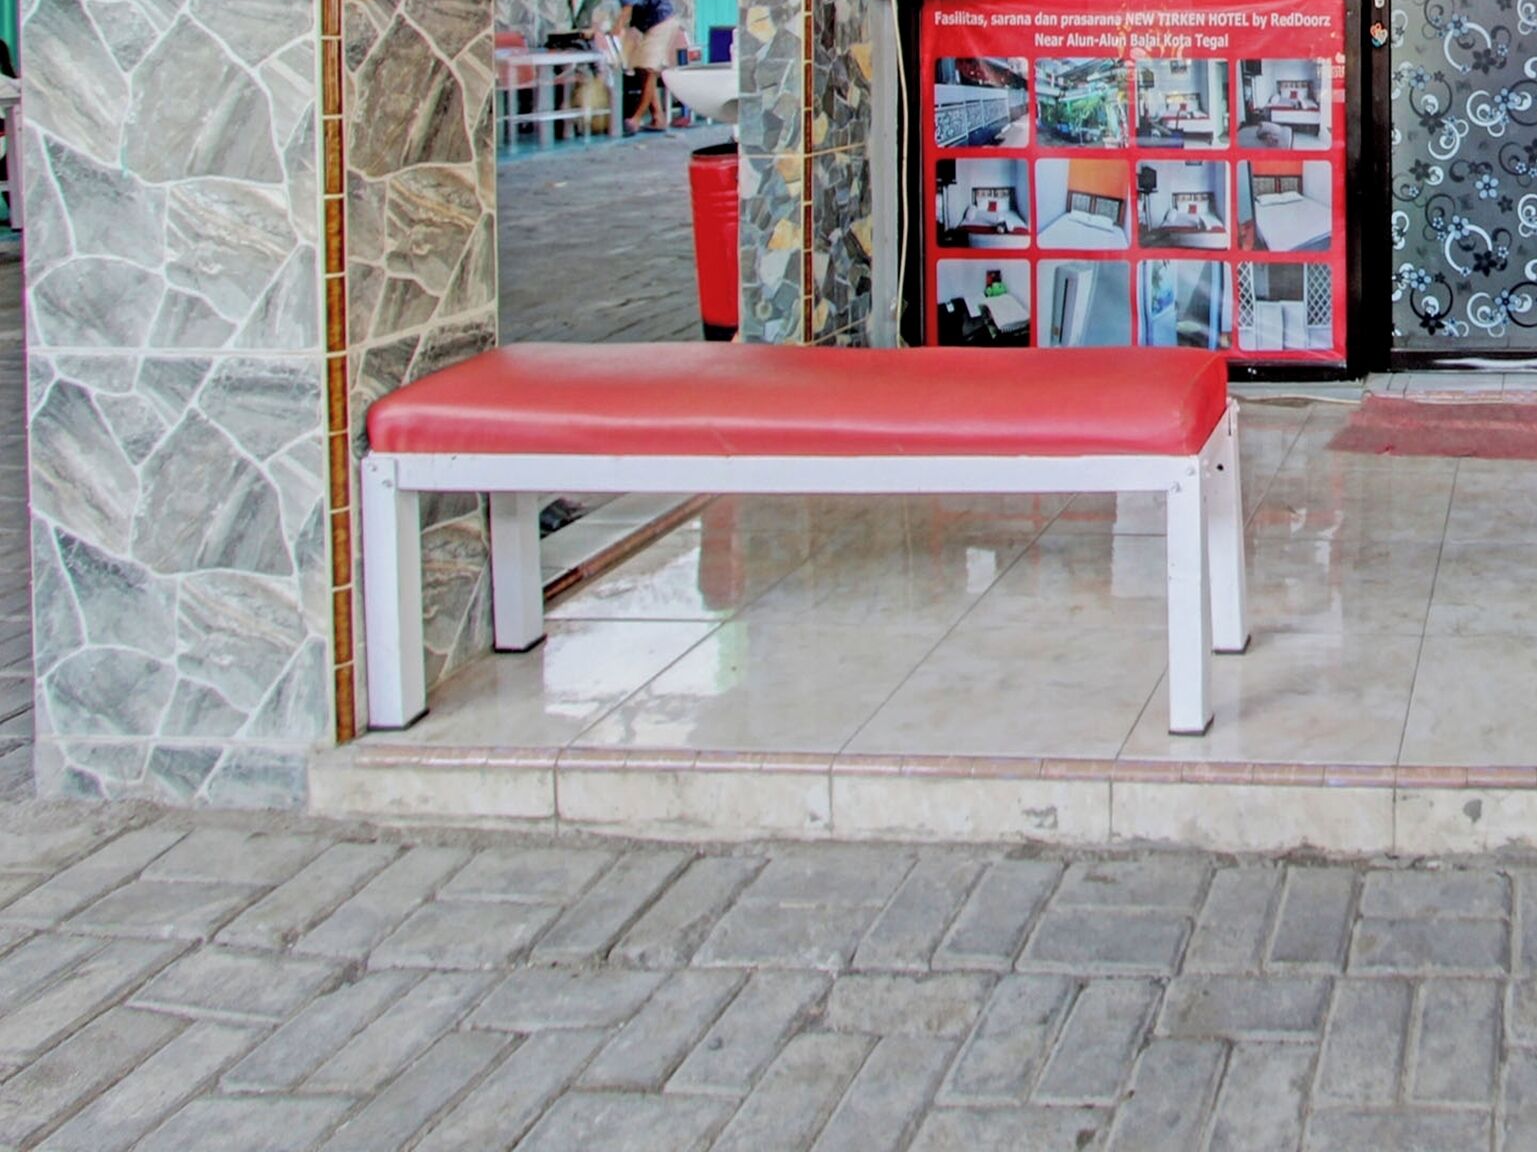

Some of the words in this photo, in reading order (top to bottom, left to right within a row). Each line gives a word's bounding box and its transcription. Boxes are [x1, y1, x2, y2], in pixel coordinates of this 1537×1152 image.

[934, 11, 988, 28] Fasilitas,
[990, 13, 1031, 26] sarana
[1034, 11, 1058, 26] dan
[1060, 13, 1122, 28] prasarana
[1124, 12, 1155, 27] NEW
[1157, 12, 1205, 27] TIRKEN
[1208, 12, 1249, 27] HOTEL
[1252, 11, 1267, 29] by
[1270, 11, 1332, 27] RedDoorz
[1034, 33, 1064, 47] Near
[1066, 33, 1126, 47] Alun-Alun
[1130, 33, 1161, 48] Balai
[1163, 33, 1192, 47] Kota
[1194, 33, 1230, 50] Tegal
